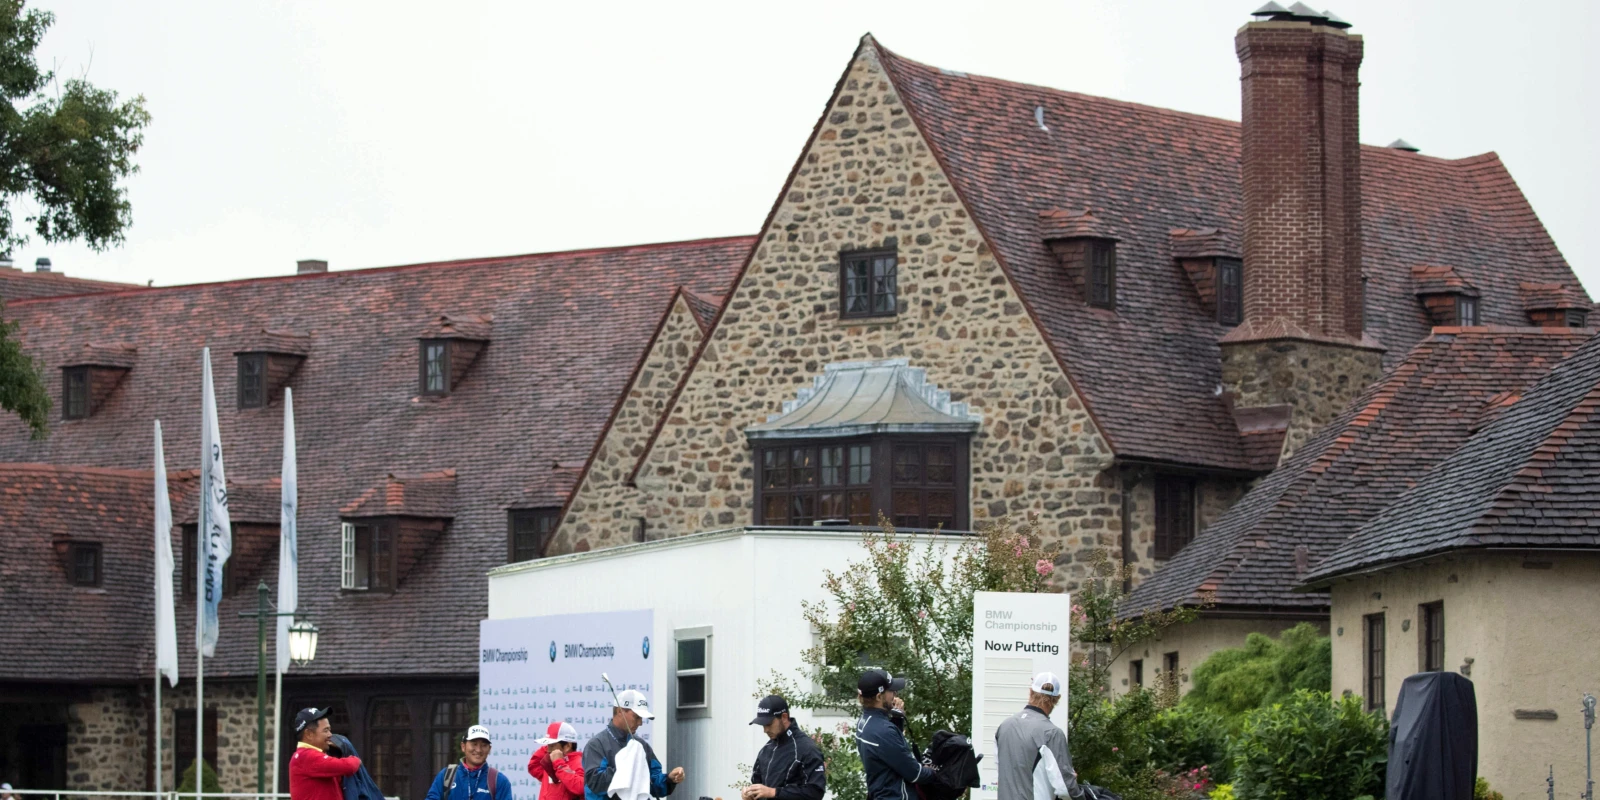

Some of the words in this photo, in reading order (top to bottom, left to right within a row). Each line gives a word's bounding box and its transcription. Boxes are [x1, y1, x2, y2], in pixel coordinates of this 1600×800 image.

[985, 610, 1013, 619] BMW
[985, 620, 1058, 633] Championship
[482, 648, 495, 662] BMW
[495, 646, 528, 664] Championship
[564, 643, 578, 658] BMW
[579, 642, 615, 660] Championship
[984, 640, 1013, 652] Now
[1015, 641, 1059, 656] Putting
